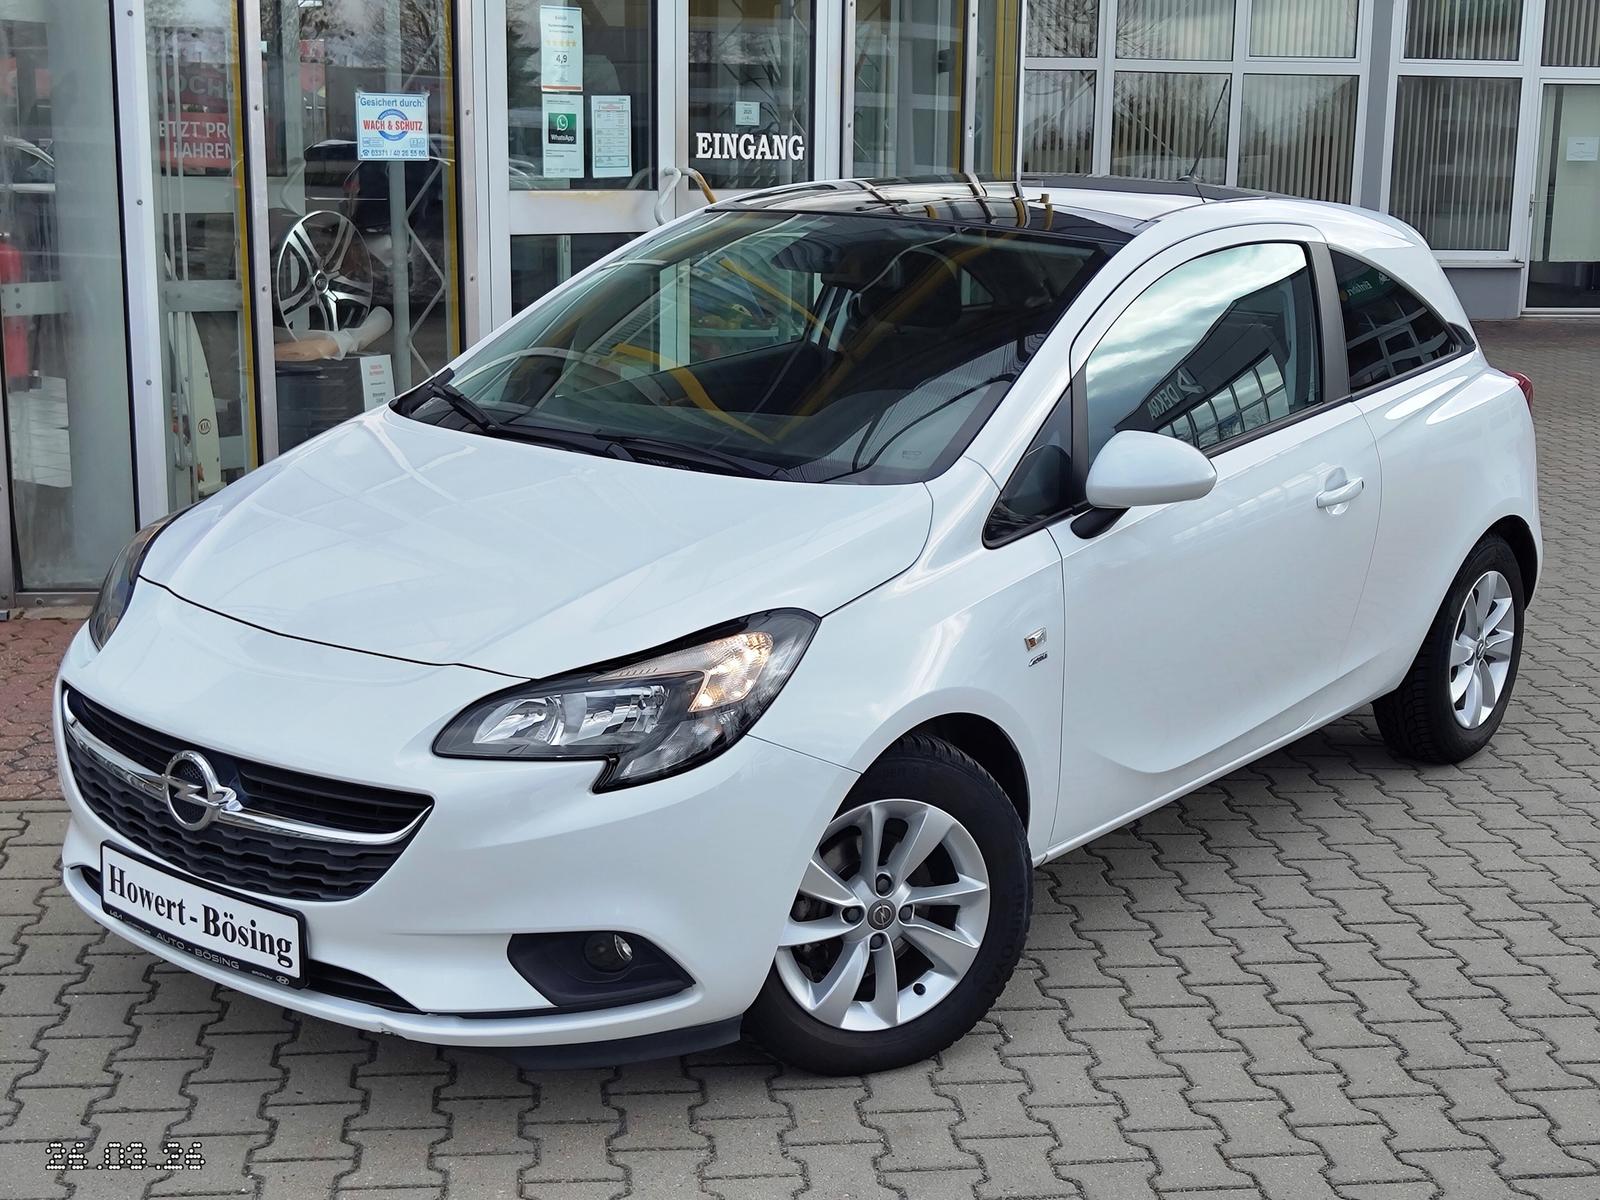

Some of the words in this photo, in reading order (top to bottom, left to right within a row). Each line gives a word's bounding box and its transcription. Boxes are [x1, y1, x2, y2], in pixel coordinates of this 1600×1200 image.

[555, 54, 568, 64] 4,9
[360, 97, 397, 107] Gesichert
[206, 122, 231, 138] PR
[363, 120, 385, 130] WACH
[387, 120, 393, 130] &
[395, 120, 423, 131] SCHUTZ
[551, 134, 575, 142] WhatsApp
[695, 132, 805, 161] EINGANG
[156, 932, 185, 950] AUTO
[194, 946, 240, 970] BÖSING
